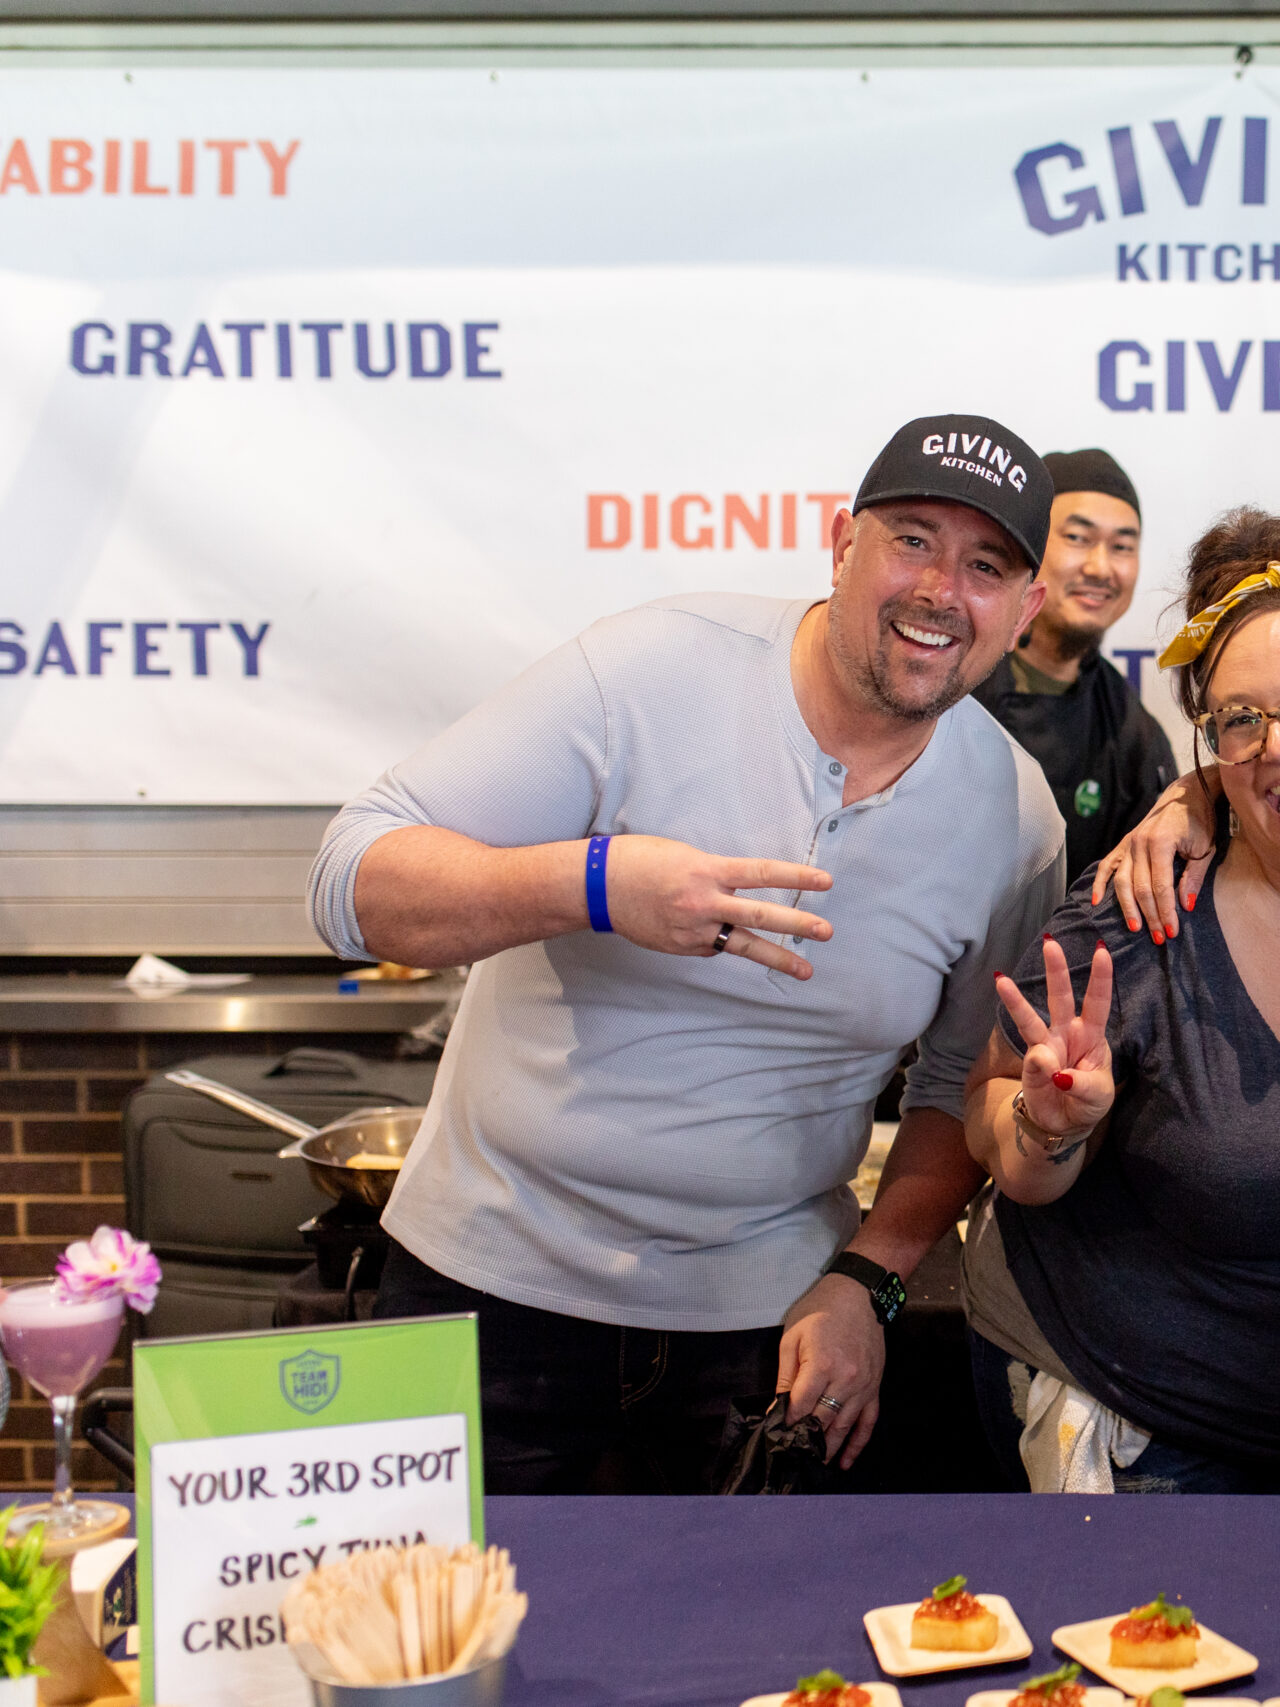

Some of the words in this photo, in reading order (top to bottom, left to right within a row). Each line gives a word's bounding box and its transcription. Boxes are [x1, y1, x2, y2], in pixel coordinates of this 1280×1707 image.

[0, 139, 301, 196] ABILITY
[70, 321, 503, 379] GRATITUDE
[922, 432, 1027, 493] GIVING
[940, 456, 1002, 487] KITCHEN
[586, 493, 850, 551] DIGNIT
[0, 622, 272, 677] SAFETY
[290, 1371, 328, 1384] TEAM
[168, 1466, 277, 1507] YOUR
[286, 1460, 360, 1497] 3RD
[372, 1446, 460, 1488] SPOT
[219, 1545, 327, 1587] SPICY
[182, 1613, 287, 1654] CRIS
